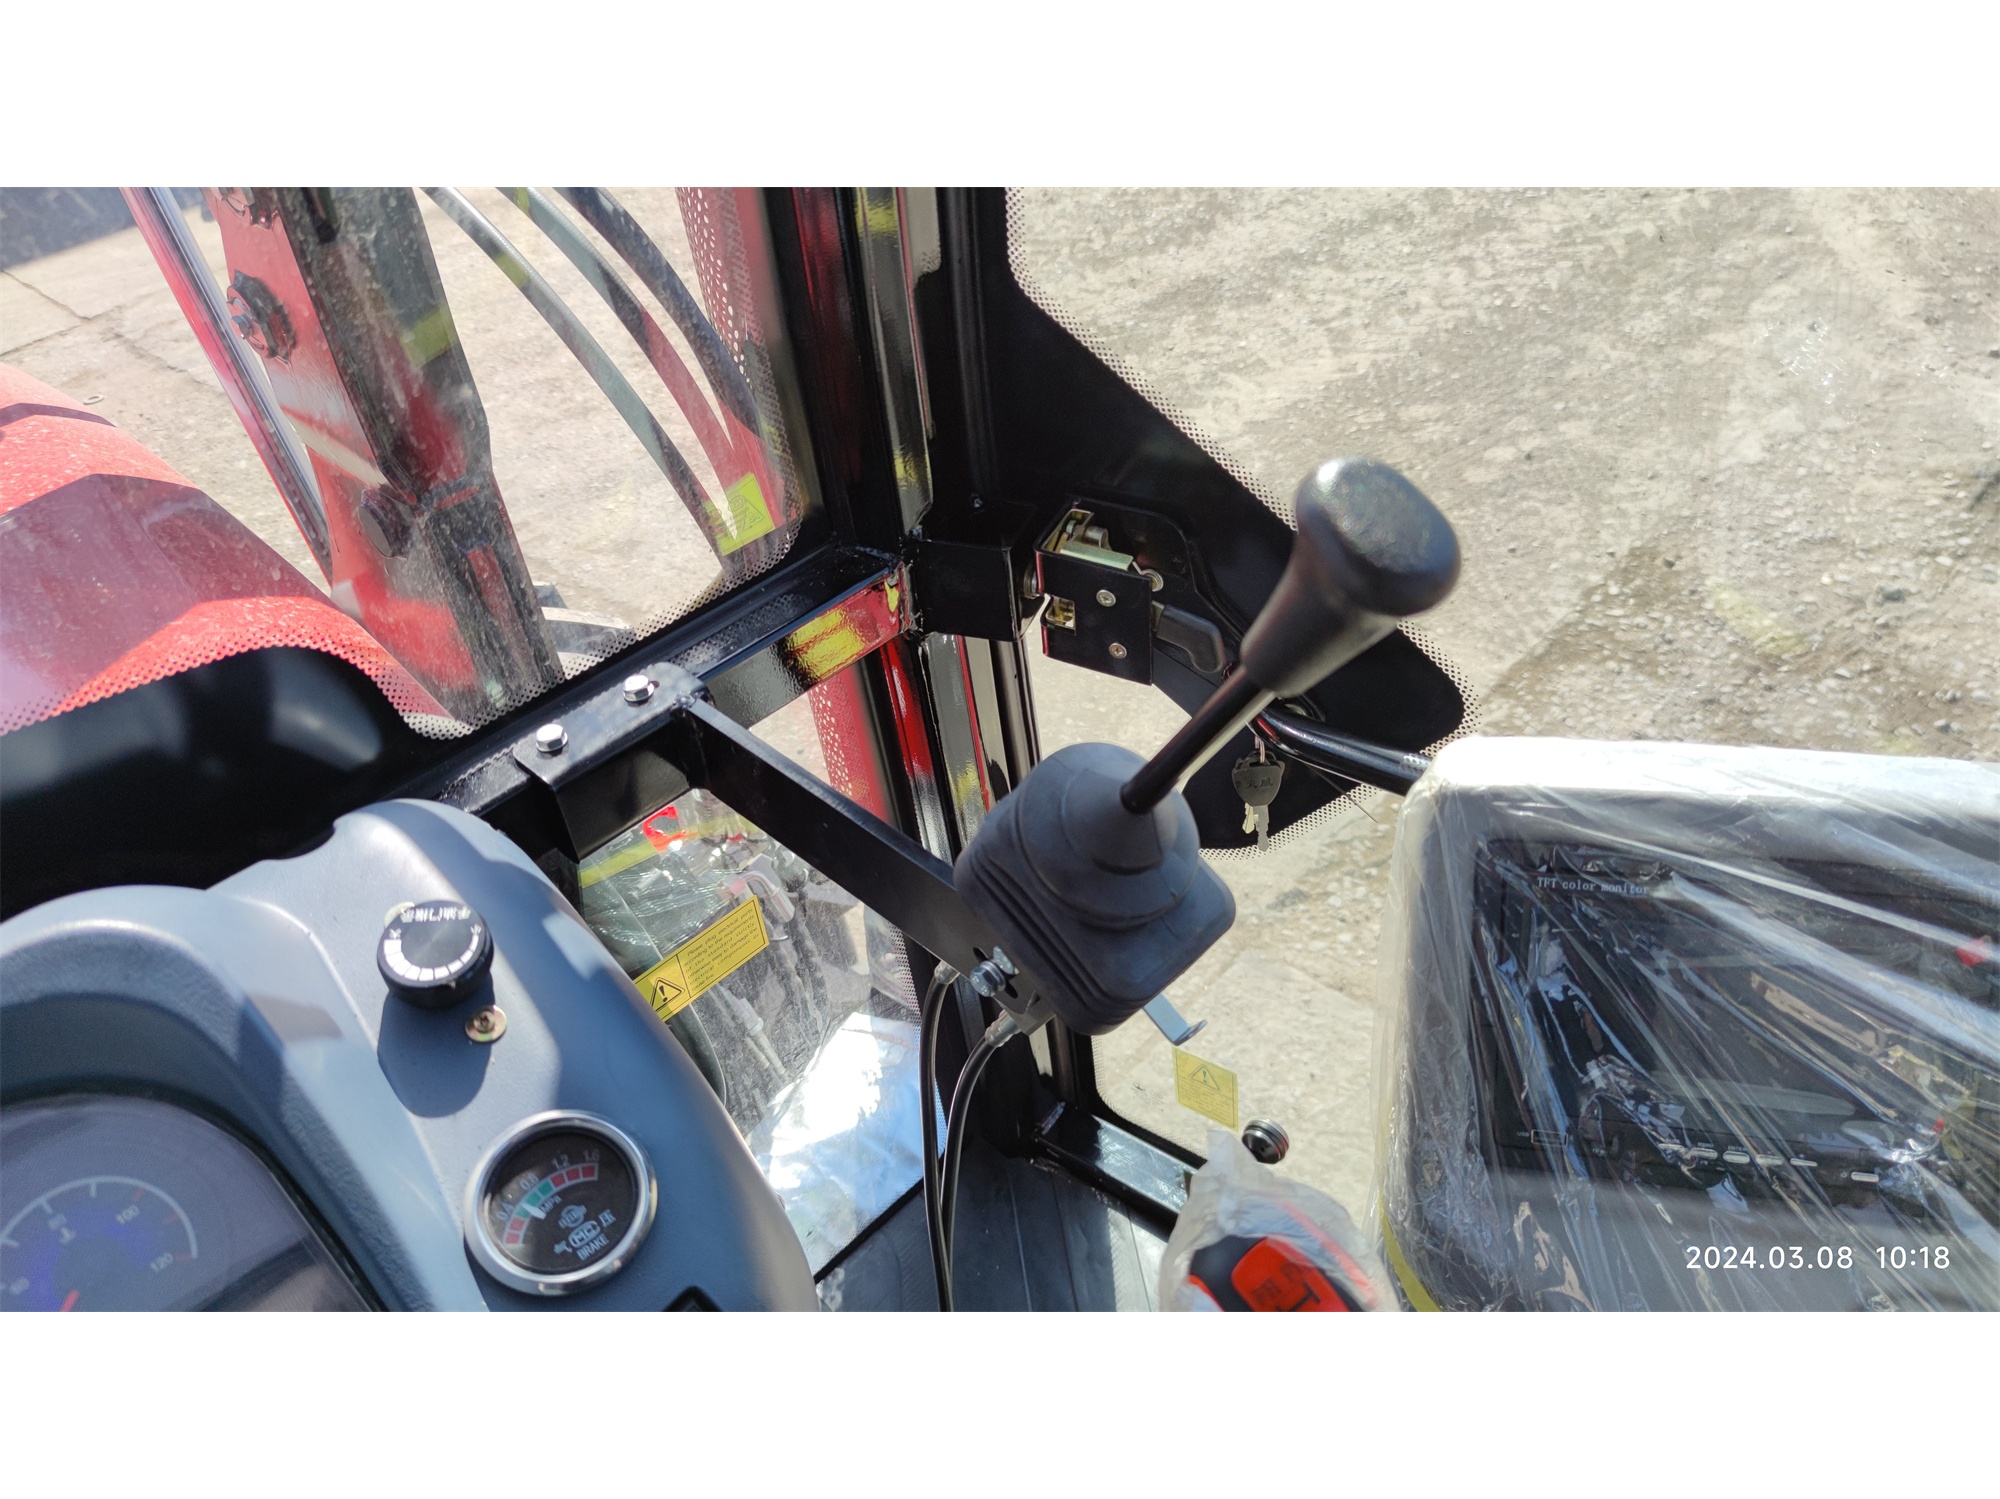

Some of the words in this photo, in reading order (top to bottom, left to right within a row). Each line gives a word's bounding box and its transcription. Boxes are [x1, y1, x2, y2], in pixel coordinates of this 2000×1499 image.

[1537, 877, 1557, 888] TFT
[1562, 880, 1595, 891] color
[1601, 884, 1649, 894] monitor
[687, 944, 703, 956] Please
[704, 934, 716, 945] plug
[708, 937, 732, 957] standard
[576, 1233, 609, 1260] BRAKE
[151, 1252, 174, 1272] 120
